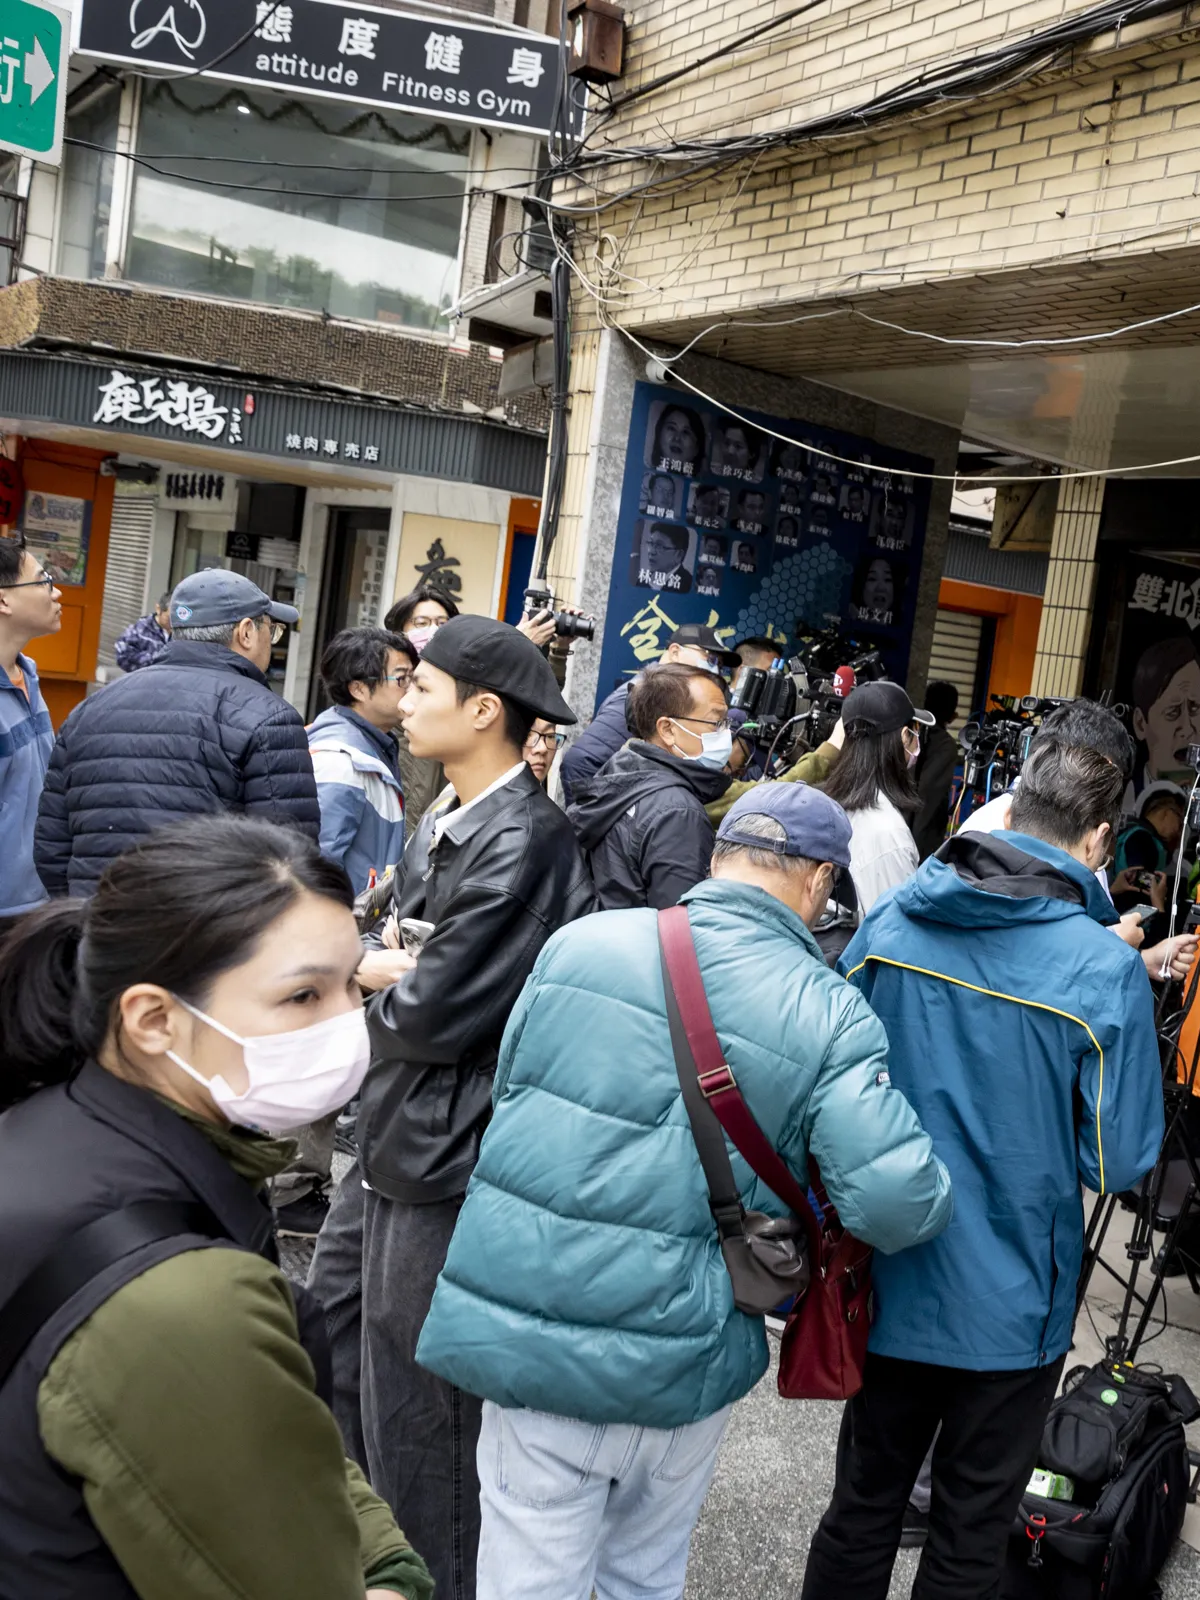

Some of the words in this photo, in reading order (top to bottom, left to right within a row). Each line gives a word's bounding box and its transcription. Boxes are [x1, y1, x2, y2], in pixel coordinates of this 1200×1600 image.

[254, 1, 546, 88] 態度健身
[255, 52, 359, 87] attitude
[381, 71, 471, 107] Fitness
[476, 88, 532, 118] Gym
[638, 567, 682, 590] 林思銘
[858, 606, 894, 625] 馬文君
